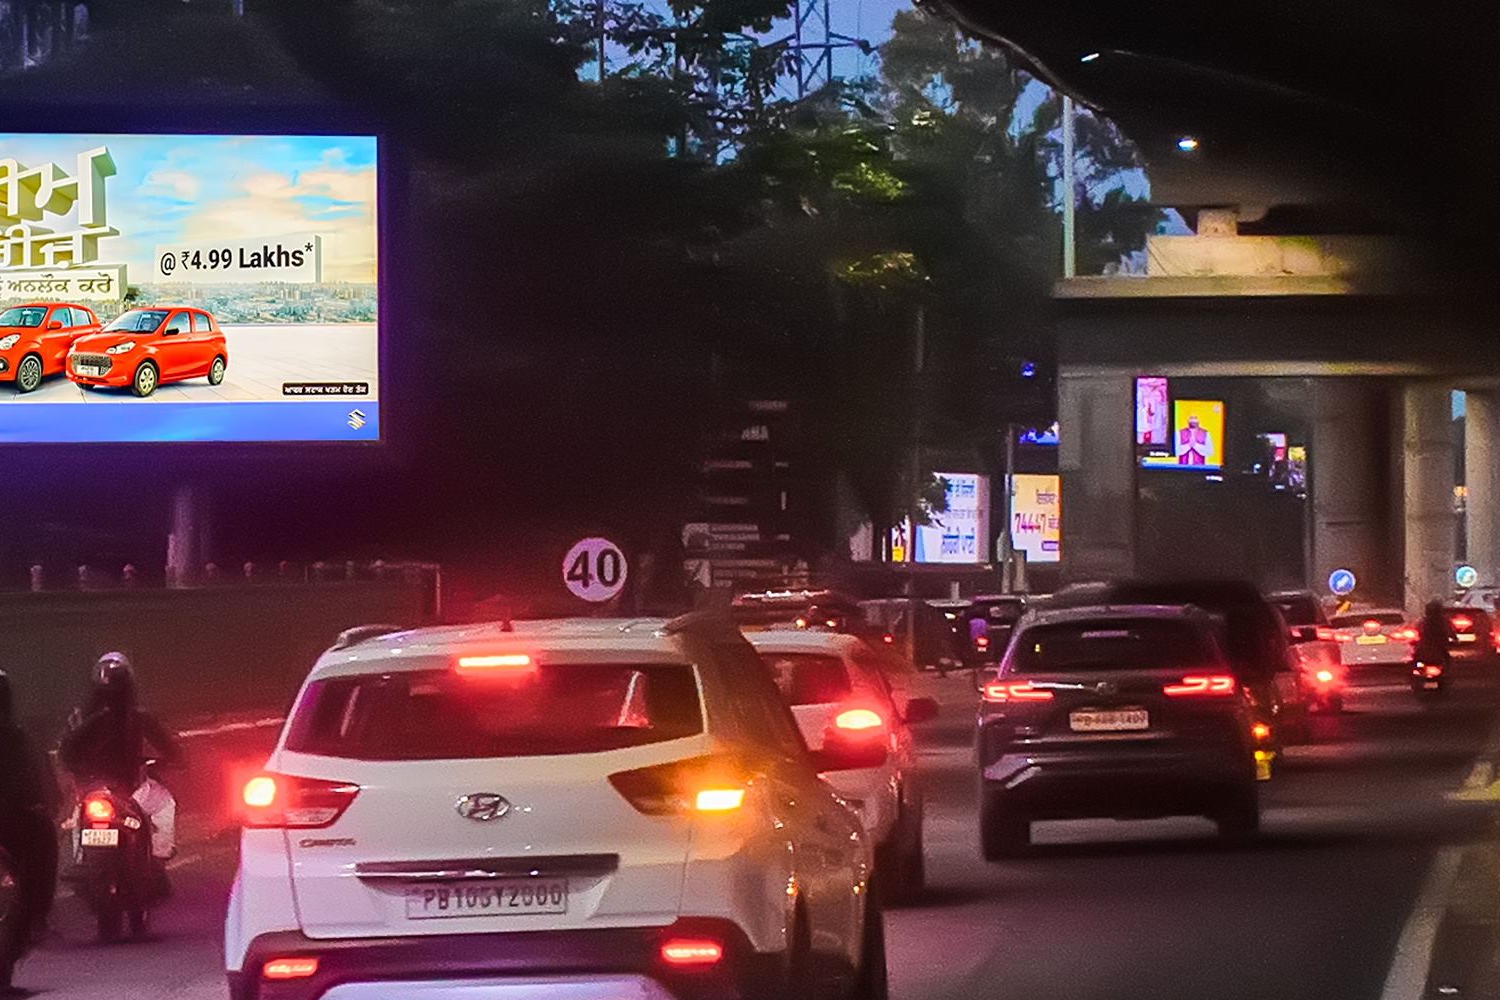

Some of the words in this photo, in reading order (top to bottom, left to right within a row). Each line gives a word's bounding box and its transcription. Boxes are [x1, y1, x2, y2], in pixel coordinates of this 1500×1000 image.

[160, 252, 176, 276] @
[181, 248, 232, 270] ₹4.99
[566, 548, 621, 590] 40
